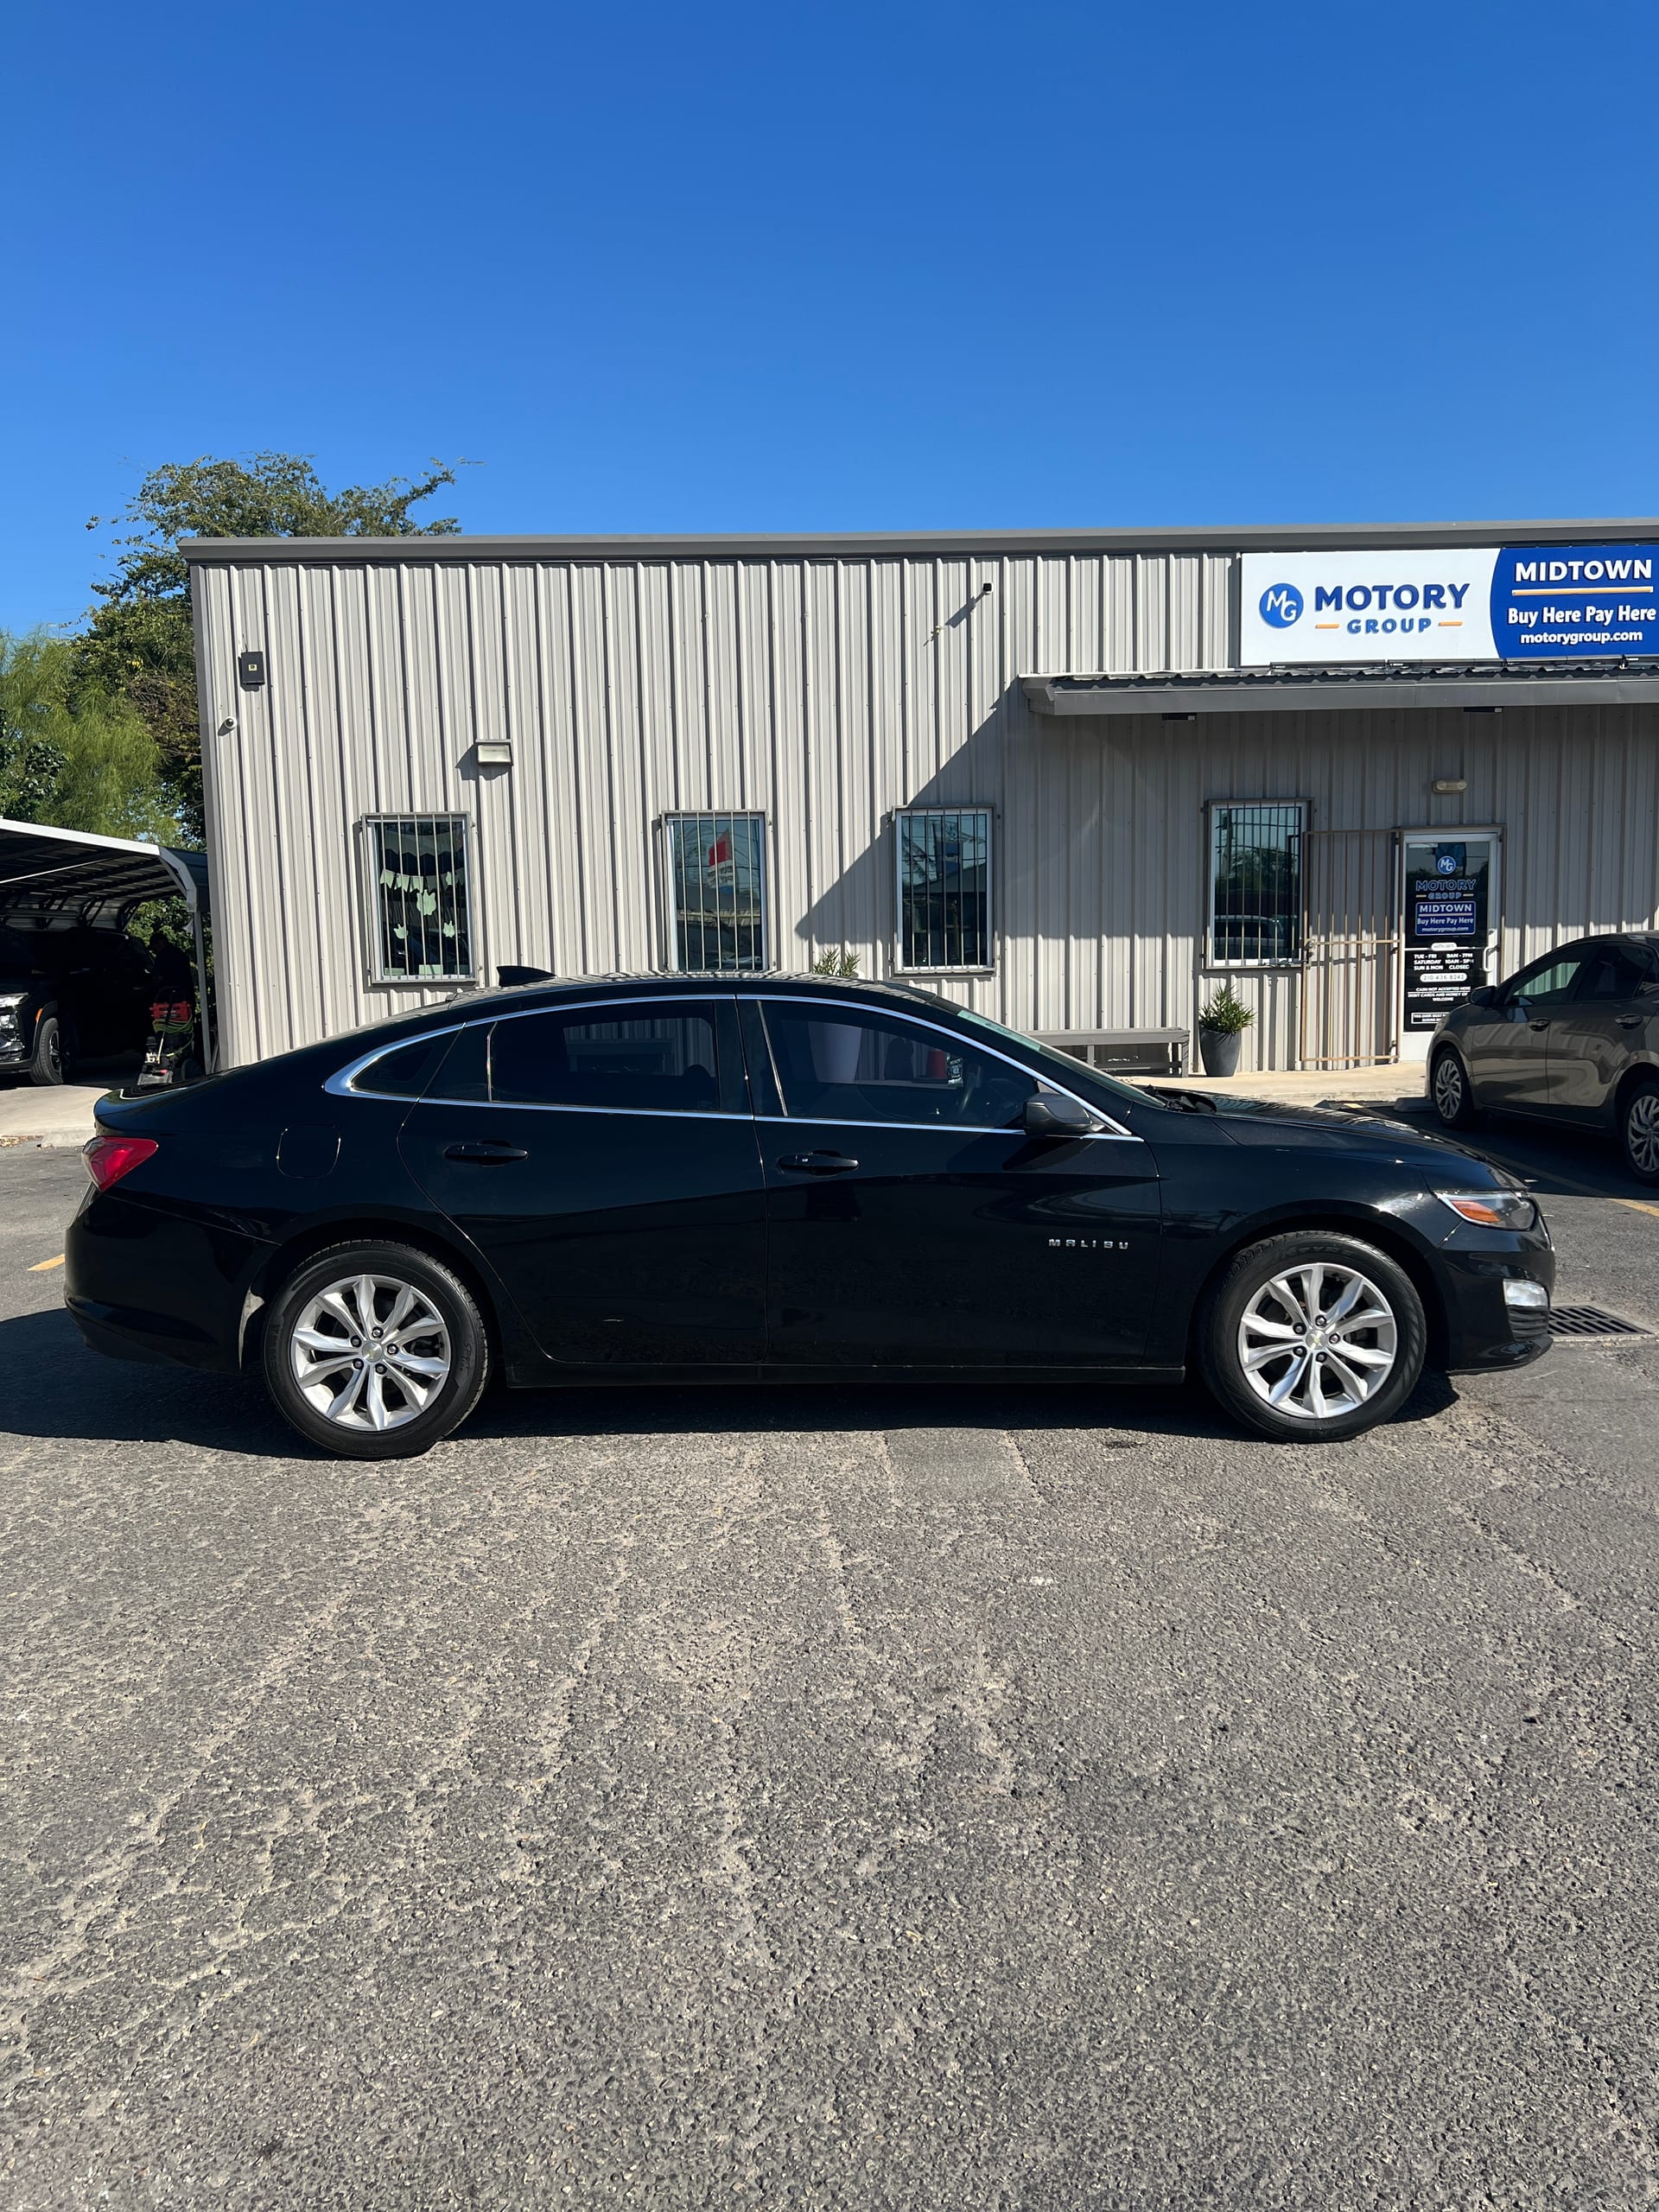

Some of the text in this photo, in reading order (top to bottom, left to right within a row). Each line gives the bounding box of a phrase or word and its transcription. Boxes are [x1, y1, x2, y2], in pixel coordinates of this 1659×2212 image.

[1515, 559, 1652, 582] MIDTOWN
[1314, 582, 1471, 612] MOTORY
[1266, 589, 1297, 622] MG
[1508, 604, 1656, 628] Buy Here Pay Here
[1346, 617, 1432, 634] GROUP
[1520, 631, 1643, 645] motorygroup.com
[1440, 858, 1453, 872] MG
[1415, 879, 1477, 892] MOTORY
[1427, 892, 1462, 900] GROUP
[1420, 904, 1472, 913] MIDTOWN
[1417, 918, 1429, 926] Buy
[1446, 917, 1459, 925] Pay
[1048, 1238, 1128, 1249] MALIBU
